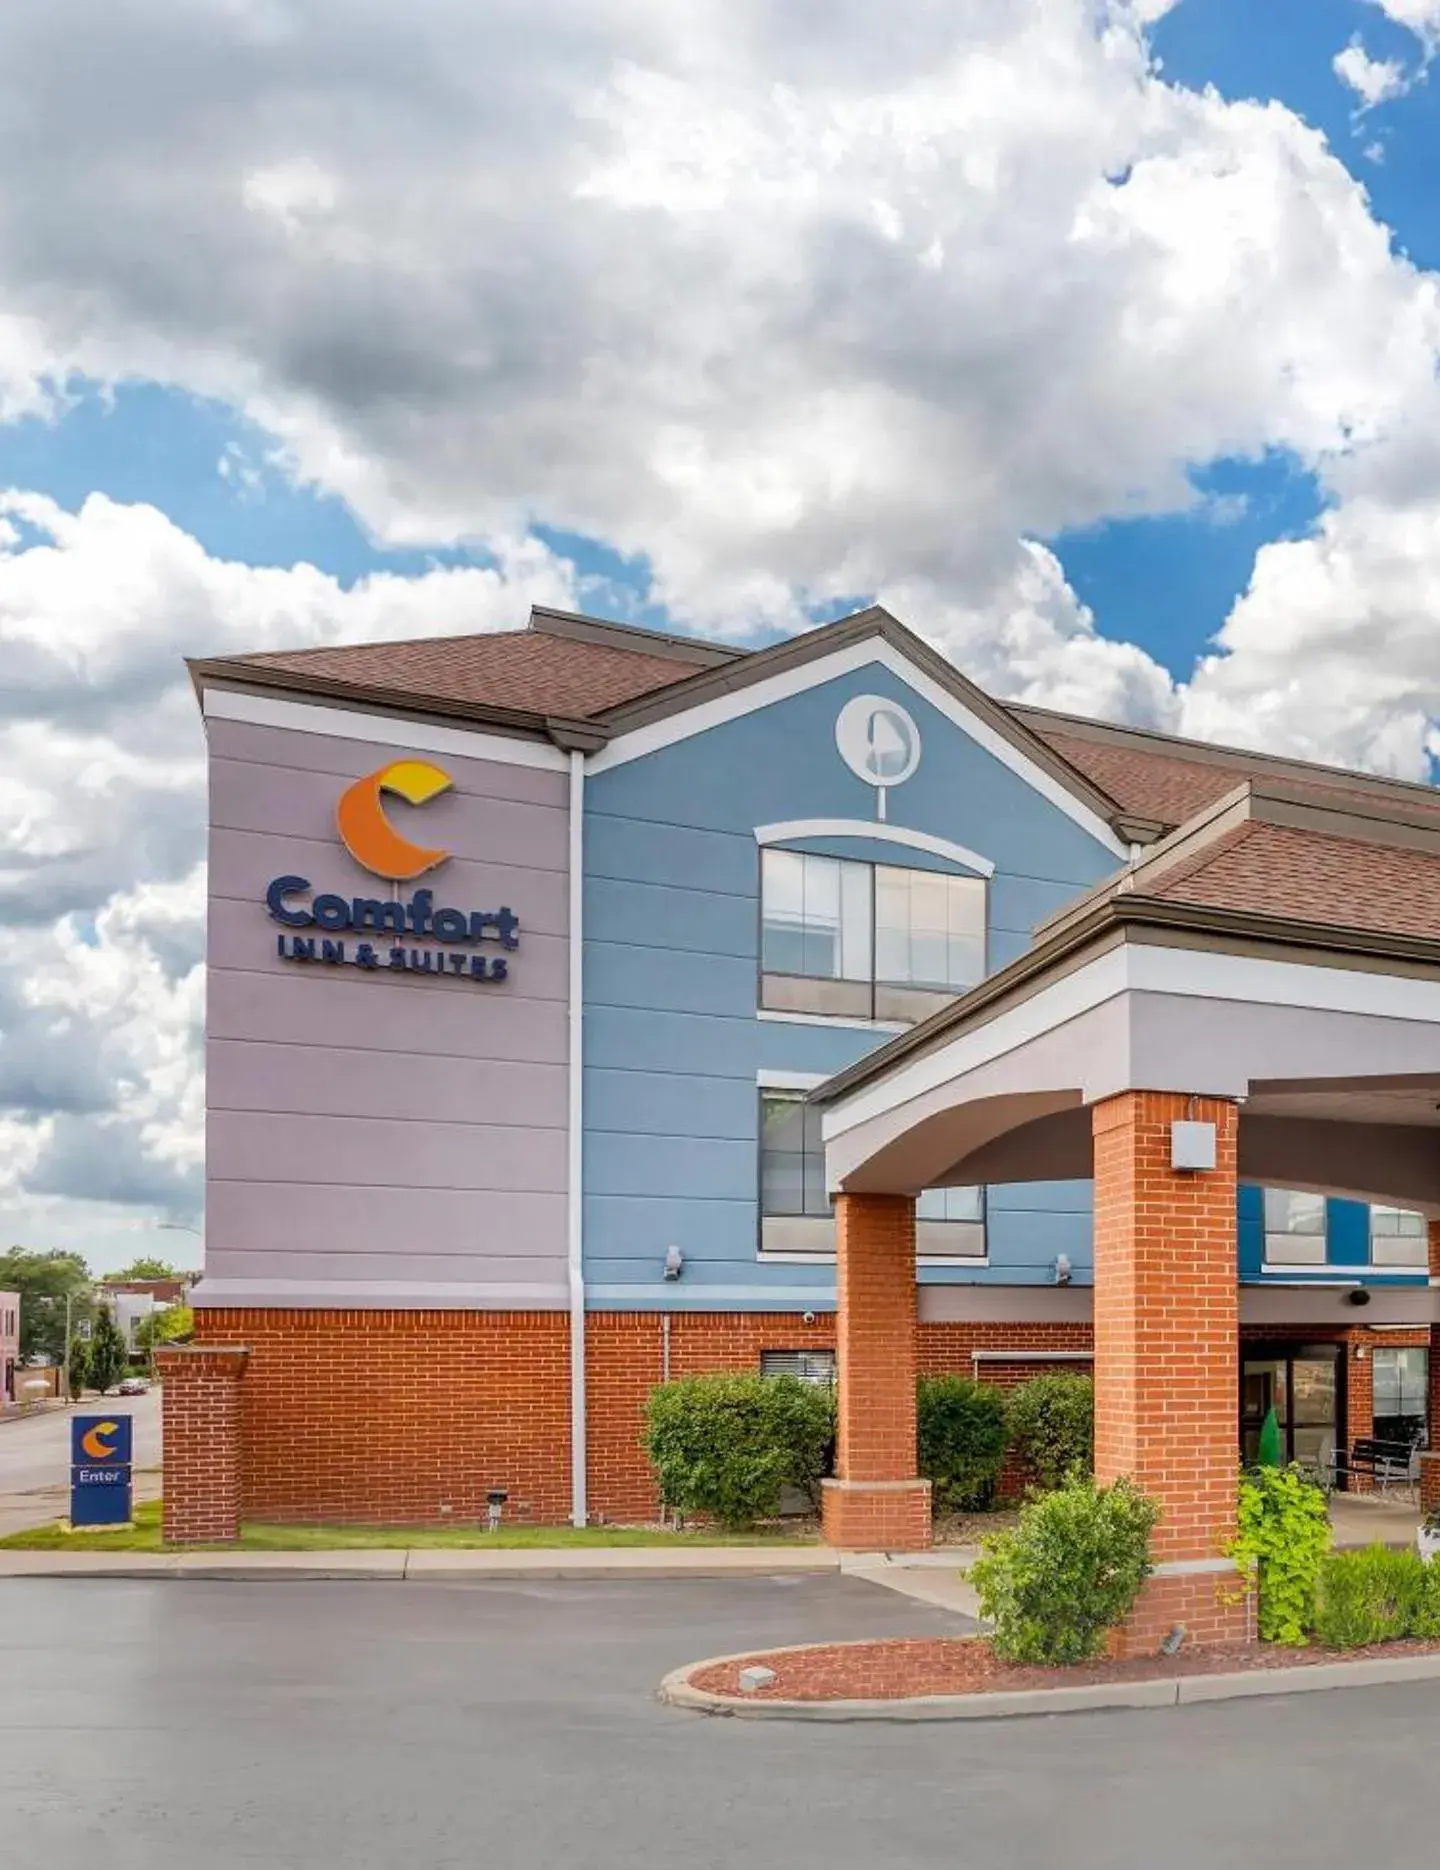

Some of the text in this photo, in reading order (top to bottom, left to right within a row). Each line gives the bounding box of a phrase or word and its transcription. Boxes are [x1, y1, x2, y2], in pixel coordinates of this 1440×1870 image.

[266, 875, 520, 951] Comfort
[277, 934, 508, 981] INN & SUITES
[79, 1470, 120, 1482] Enter
